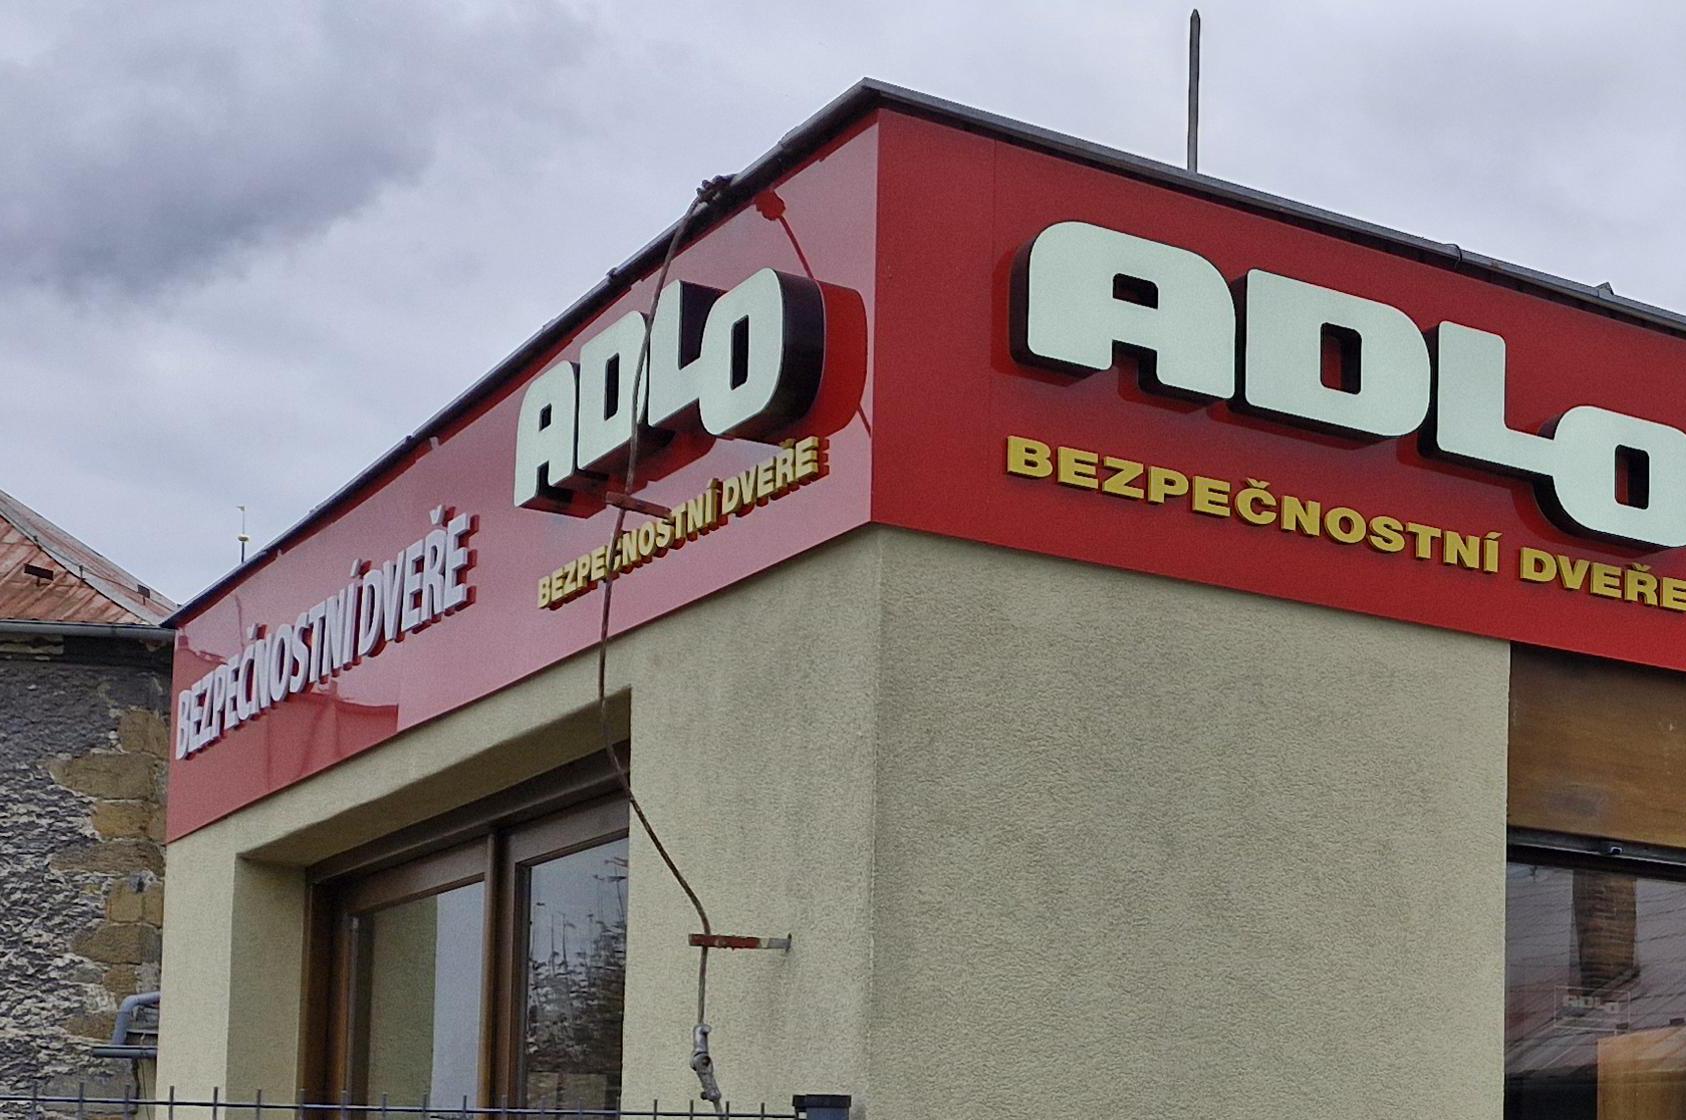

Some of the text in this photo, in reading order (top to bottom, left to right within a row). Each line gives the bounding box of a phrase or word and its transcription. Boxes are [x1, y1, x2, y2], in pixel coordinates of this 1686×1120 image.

[513, 267, 787, 508] ADLO
[722, 436, 820, 516] DVEŘE
[1006, 435, 1502, 573] BEZPEČNOSTNÍ
[175, 503, 470, 760] BEZPEČNOSTNÍ DVEŘE
